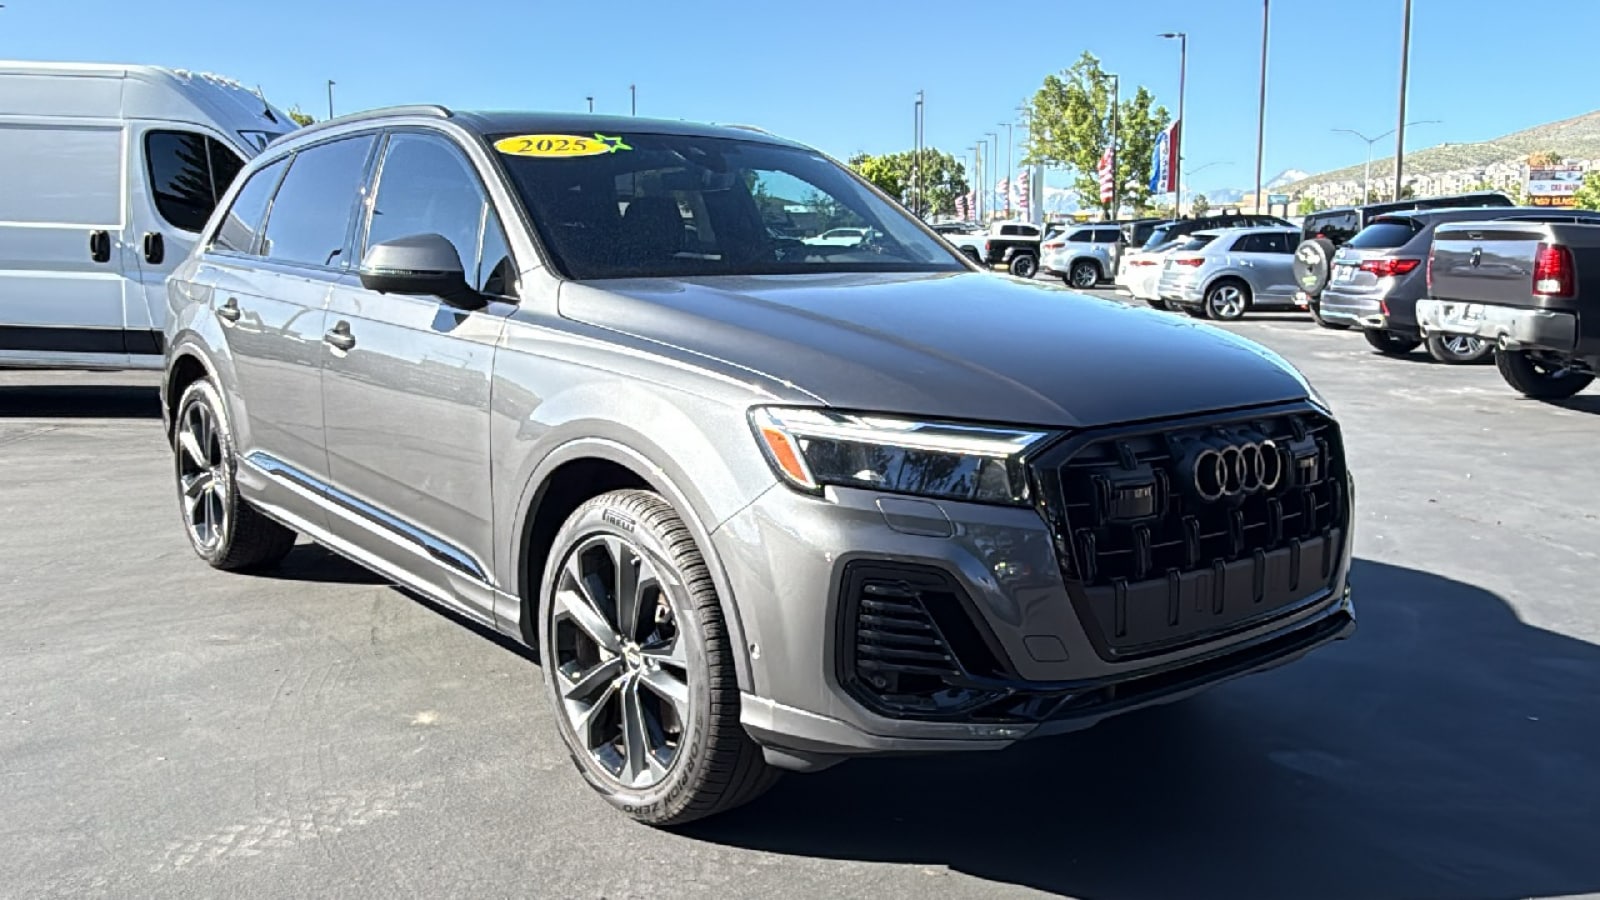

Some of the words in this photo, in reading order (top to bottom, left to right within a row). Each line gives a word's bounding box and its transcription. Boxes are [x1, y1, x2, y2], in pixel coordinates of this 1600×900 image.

[519, 139, 588, 152] 2025
[602, 508, 636, 533] PIRELLI
[623, 803, 660, 814] ZERO
